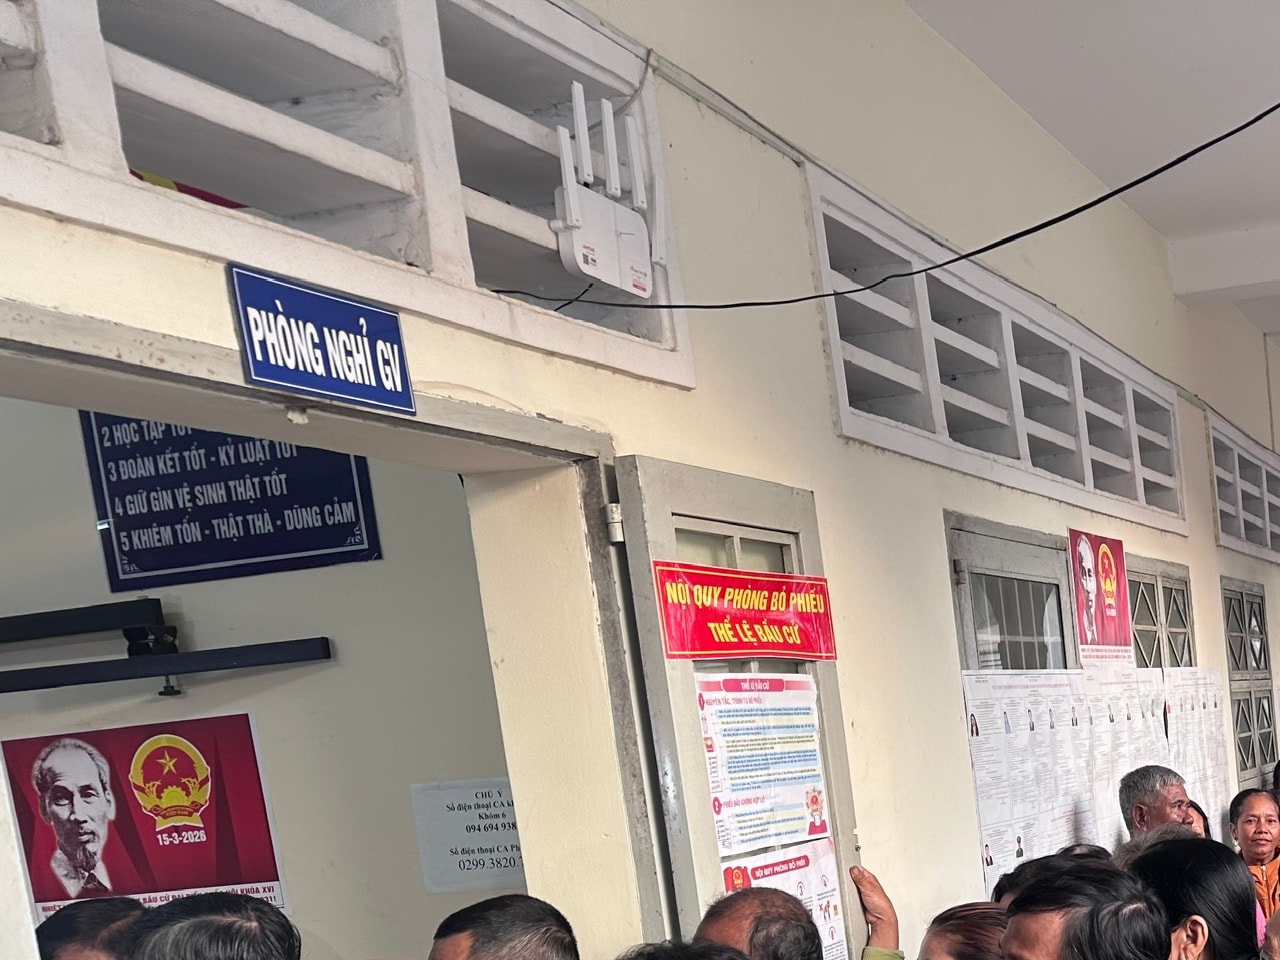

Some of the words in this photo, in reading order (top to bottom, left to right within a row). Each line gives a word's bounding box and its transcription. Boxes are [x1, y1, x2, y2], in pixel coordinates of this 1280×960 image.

[247, 300, 325, 376] PHÒNG
[323, 317, 376, 386] NGHỈ
[376, 340, 402, 392] GV
[102, 426, 112, 447] 2
[113, 422, 139, 449] HỌC
[108, 462, 117, 482] 3
[119, 454, 155, 480] ĐOÀN
[158, 448, 182, 475] KẾT
[183, 442, 206, 471] TỐT
[218, 437, 238, 467] KỶ
[240, 440, 271, 466] LUẬT
[114, 497, 123, 517] 4
[125, 489, 148, 516] GIỮ
[151, 487, 174, 513] GÌN
[175, 486, 193, 512] VỆ
[195, 482, 227, 507] SINH
[228, 474, 260, 504] THẬT
[262, 467, 288, 497] TỐT
[120, 532, 129, 552] 5
[131, 524, 173, 550] KHIÊM
[174, 515, 202, 544] TỐN
[211, 513, 244, 544] THẬT
[246, 508, 274, 534] THÀ
[284, 505, 322, 532] DŨNG
[324, 497, 356, 527] CẢM
[666, 579, 690, 609] NỘI
[693, 584, 722, 609] QUY
[724, 585, 768, 611] PHÒNG
[770, 586, 786, 611] BỎ
[789, 588, 825, 613] PHIẾU
[708, 615, 738, 642] THỂ
[736, 621, 757, 645] LỆ
[754, 618, 783, 643] BẦU
[782, 621, 801, 644] CỬ
[493, 800, 505, 809] CA
[156, 829, 206, 846] 15-3-2026
[465, 824, 481, 834] 094
[483, 823, 499, 832] 694
[496, 845, 509, 853] CA
[262, 885, 275, 894] XVI
